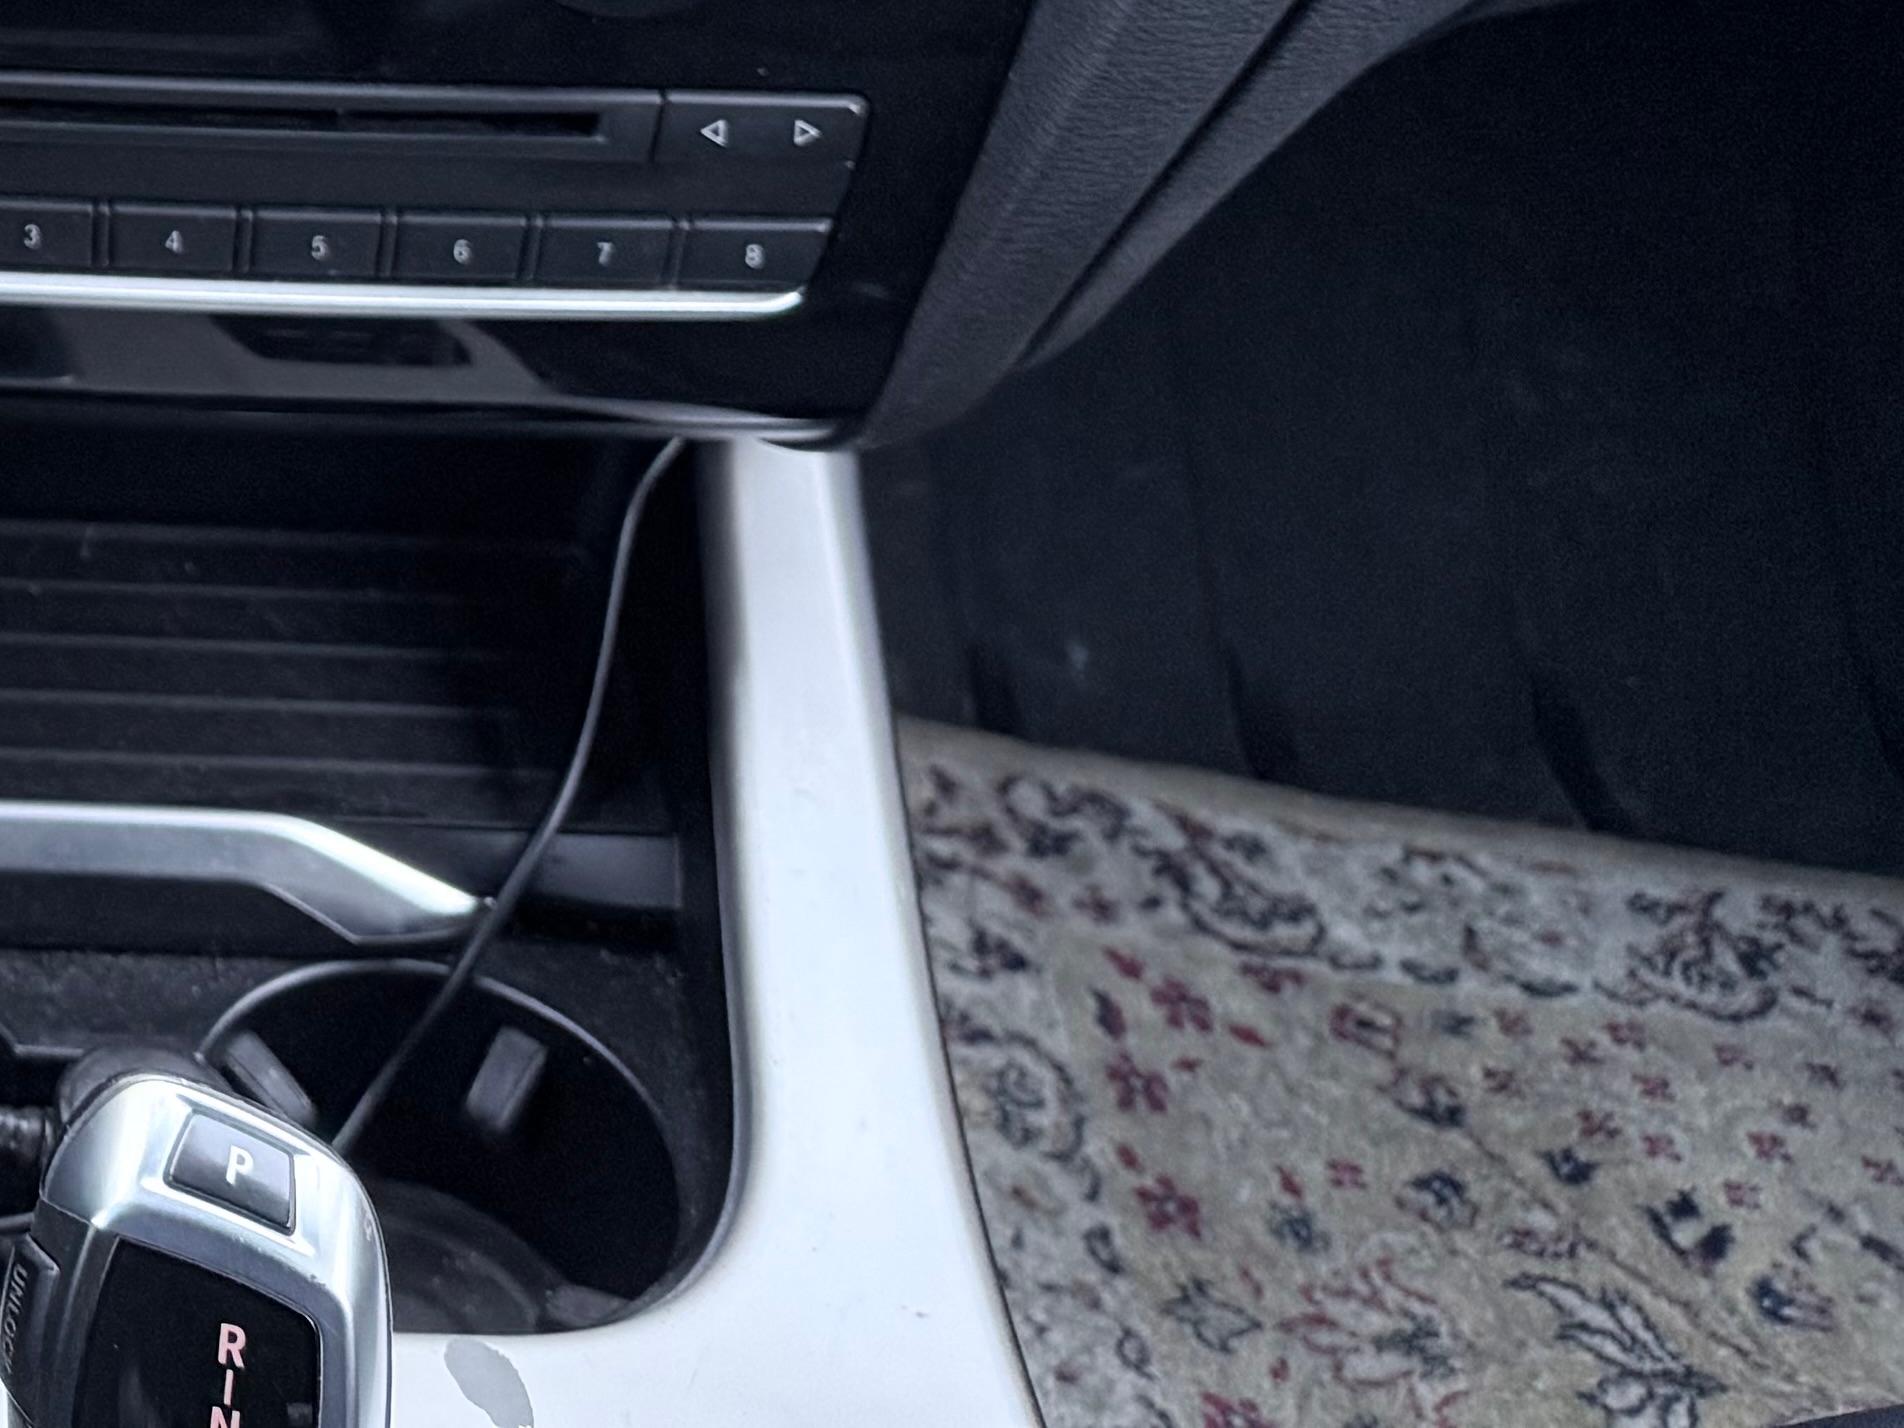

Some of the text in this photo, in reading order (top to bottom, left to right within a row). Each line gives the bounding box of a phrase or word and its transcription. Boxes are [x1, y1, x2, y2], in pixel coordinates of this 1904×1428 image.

[24, 223, 42, 249] 3
[164, 229, 184, 255] 4
[310, 234, 329, 261] 5
[452, 238, 472, 265] 6
[597, 241, 614, 266] 7
[745, 243, 765, 269] 8
[224, 1145, 254, 1185] P
[217, 1322, 247, 1369] R
